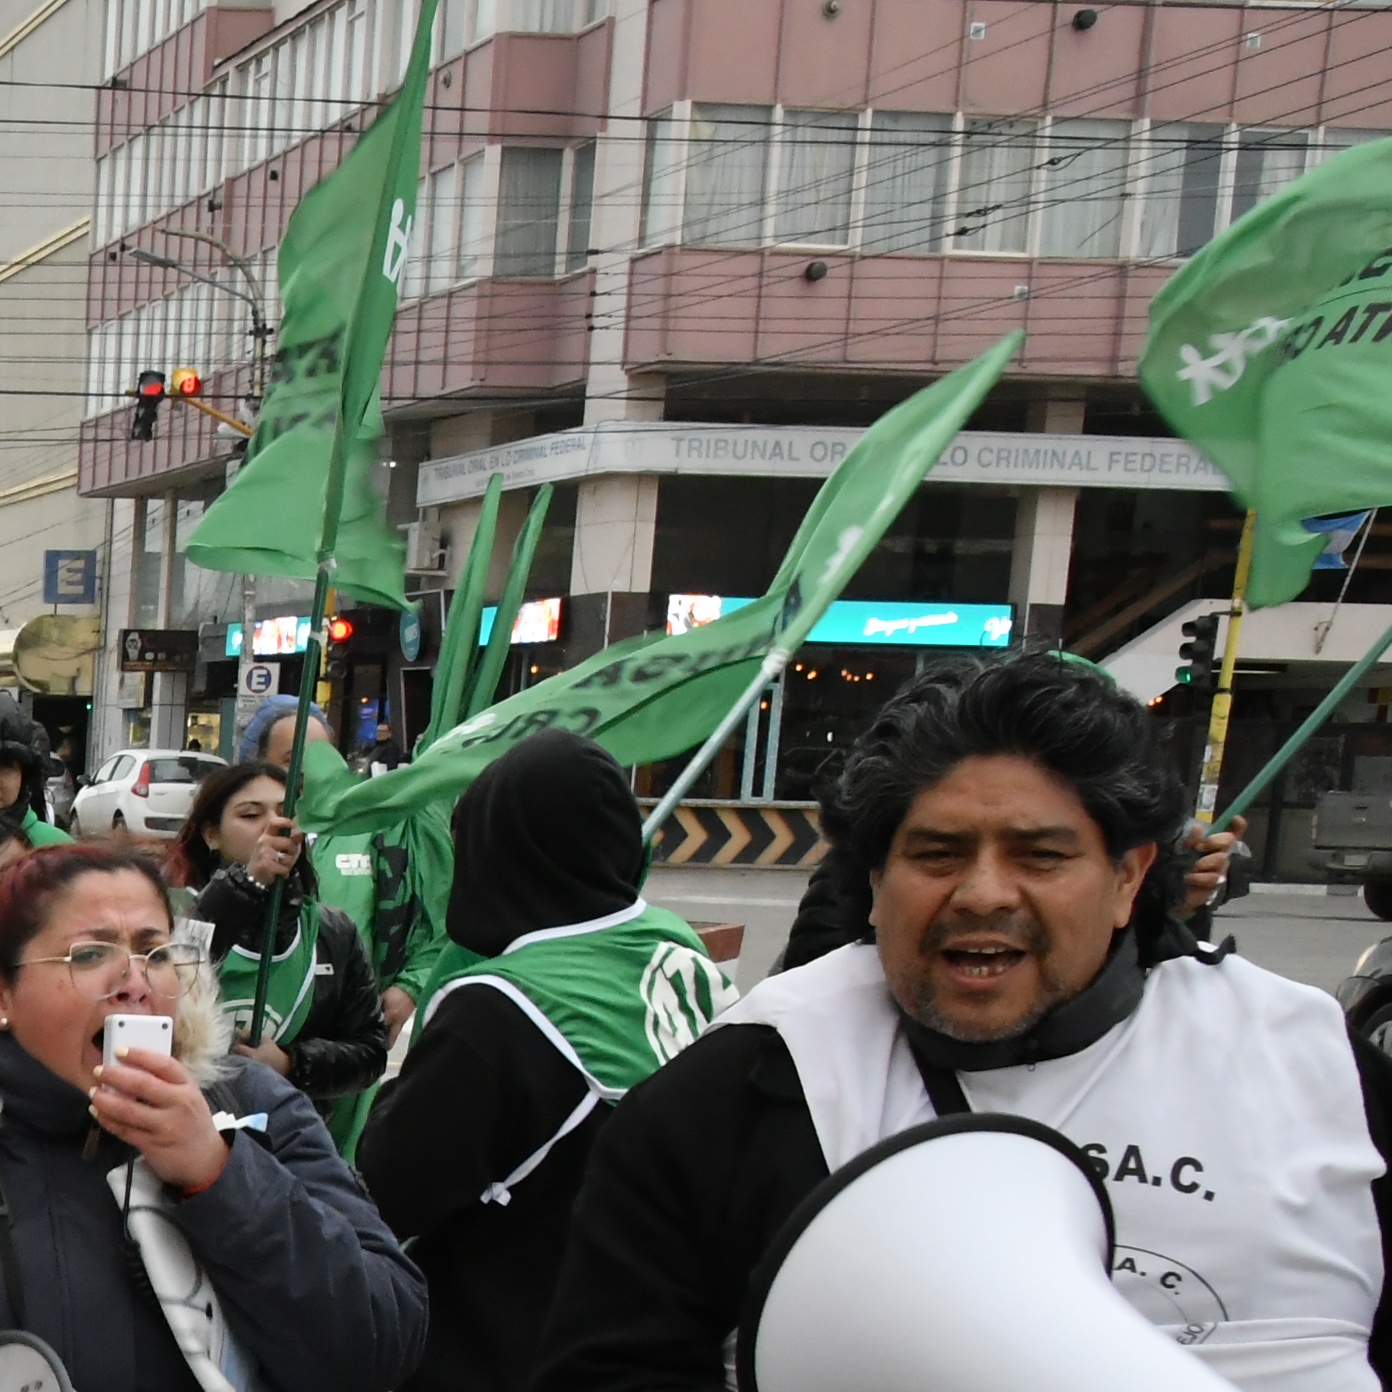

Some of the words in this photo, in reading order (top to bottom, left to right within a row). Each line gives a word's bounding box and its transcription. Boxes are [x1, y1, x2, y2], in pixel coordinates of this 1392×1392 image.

[671, 437, 800, 462] TRIBUNAL
[977, 446, 1098, 471] CRIMINAL
[57, 559, 85, 594] E
[251, 670, 267, 690] E
